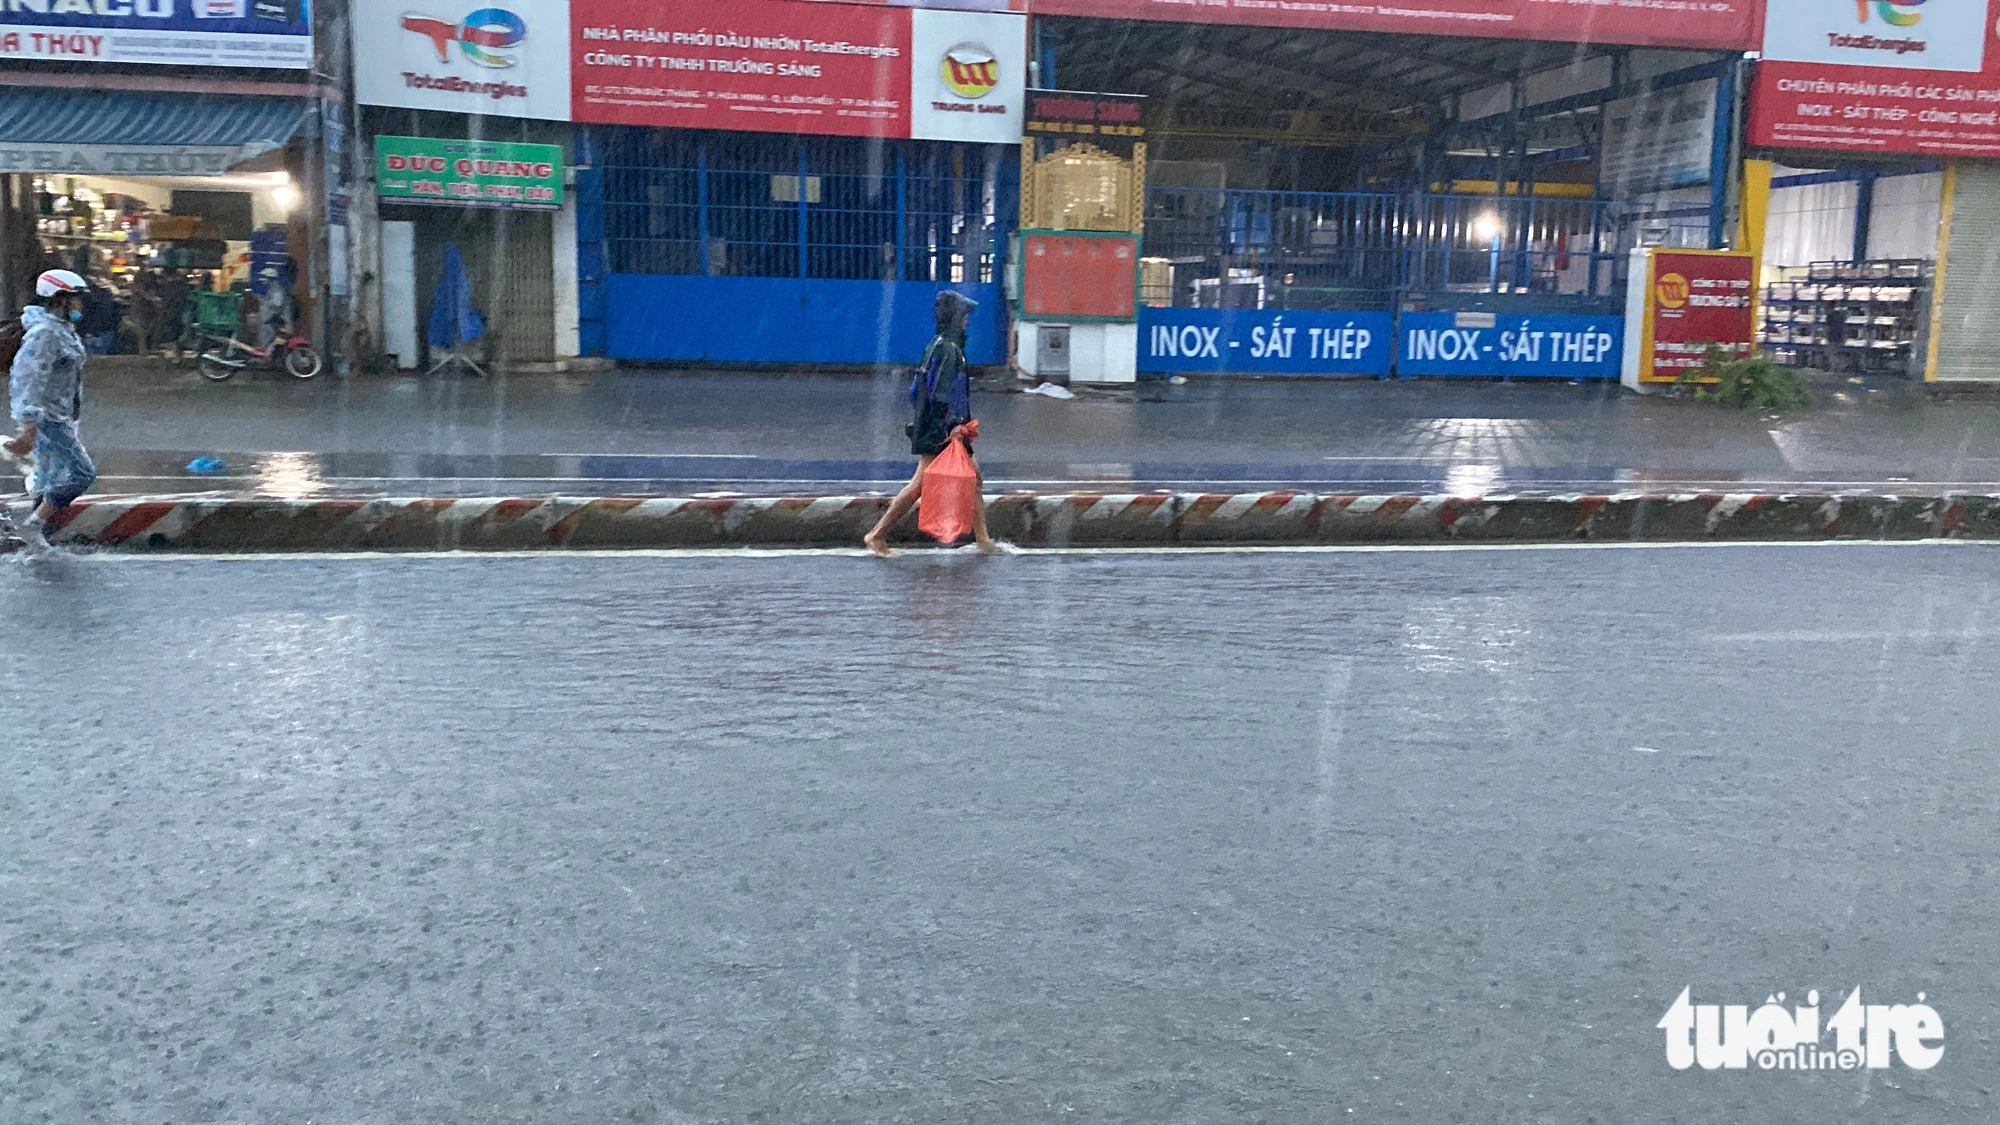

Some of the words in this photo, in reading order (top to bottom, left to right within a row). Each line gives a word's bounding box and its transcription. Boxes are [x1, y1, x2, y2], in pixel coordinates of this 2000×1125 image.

[583, 24, 621, 41] NHÀ
[623, 27, 670, 44] PHÂN
[672, 27, 713, 46] PHỐI
[715, 29, 751, 49] DẦU
[802, 39, 900, 59] TotalEnergies
[1828, 32, 1927, 54] TotalEnergies
[583, 48, 632, 67] CÔNG
[633, 55, 656, 68] TY
[657, 56, 705, 71] TNHH
[706, 56, 775, 75] TRƯỜNG
[776, 60, 822, 77] SÁNG
[401, 71, 528, 99] TotalEnergies
[1776, 77, 1835, 94] CHUYÊN
[1836, 80, 1877, 97] PHÂN
[1877, 81, 1914, 98] PHỐI
[1914, 83, 1944, 99] CÁC
[1797, 103, 1833, 117] INOX
[1843, 101, 1872, 119] SẮT
[1872, 105, 1909, 121] THÉP
[1918, 107, 1959, 123] CÔNG
[386, 153, 448, 173] ĐỨC
[454, 158, 554, 178] QUANG
[1150, 325, 1221, 358] INOX
[1250, 315, 1297, 358] SẮT
[1308, 321, 1371, 360] THÉP
[1407, 329, 1481, 361] INOX
[1498, 319, 1545, 362] SẮT
[1550, 325, 1613, 362] THÉP
